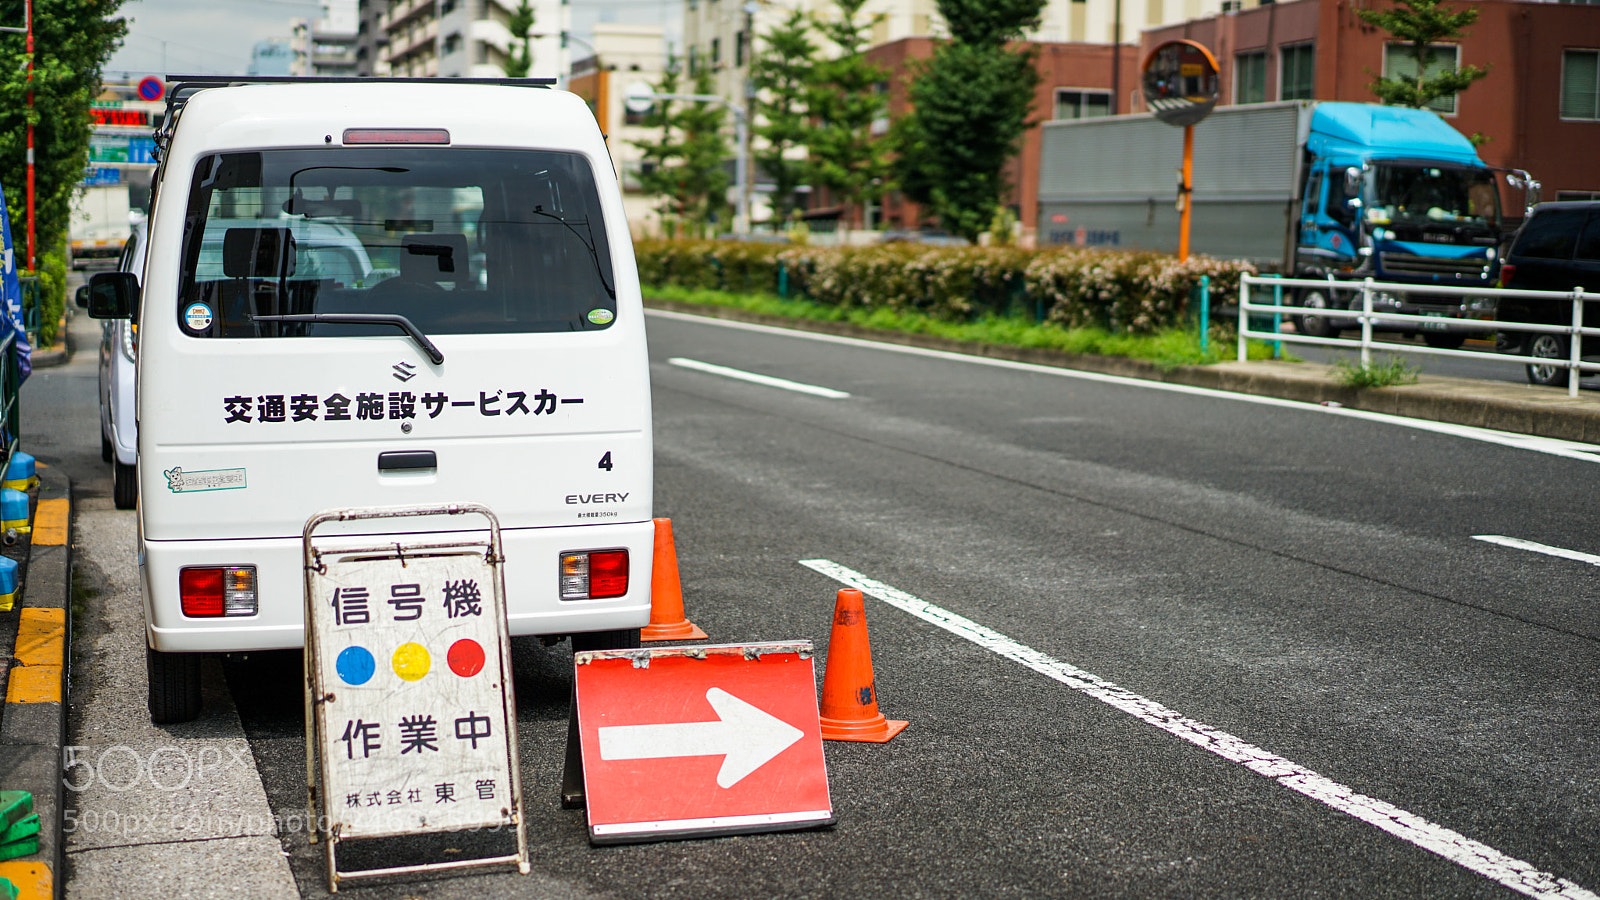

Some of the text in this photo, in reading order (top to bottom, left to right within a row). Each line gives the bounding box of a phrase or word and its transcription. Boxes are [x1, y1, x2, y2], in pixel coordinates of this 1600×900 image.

[223, 388, 585, 424] 交通安全施設サービスカー
[598, 451, 613, 472] 4
[565, 492, 630, 505] EVERY
[331, 579, 482, 626] 信号機
[341, 711, 491, 760] 作業中
[346, 778, 496, 808] 株式会社 東管
